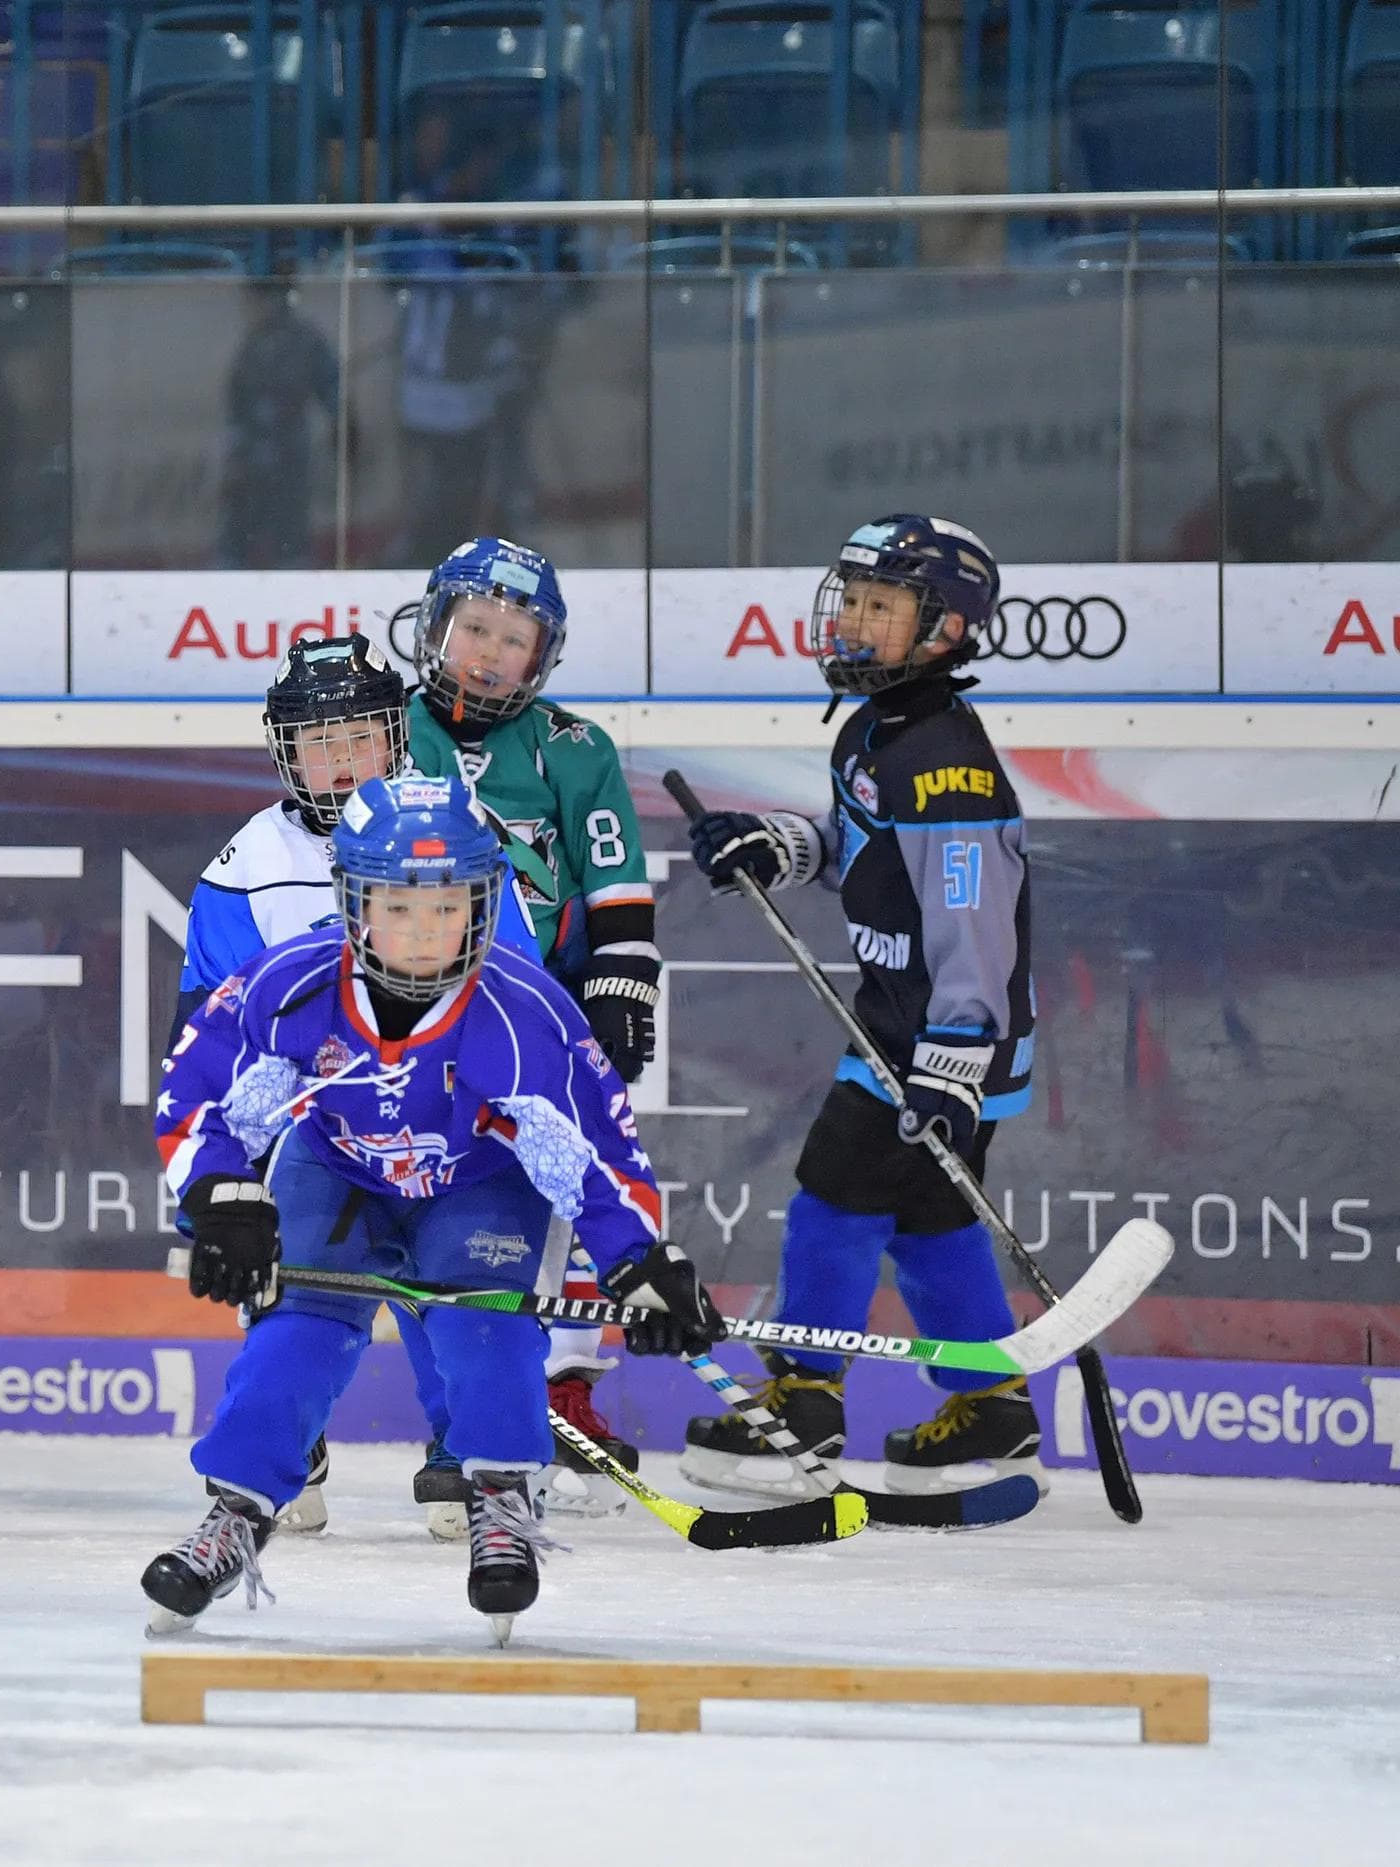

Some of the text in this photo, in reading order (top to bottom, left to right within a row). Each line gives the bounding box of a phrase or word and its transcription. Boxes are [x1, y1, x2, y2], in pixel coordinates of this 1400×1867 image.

[726, 604, 836, 659] Au
[913, 766, 995, 813] JUKE!
[400, 857, 457, 868] BAUER
[586, 808, 627, 868] 8
[942, 840, 982, 910] 51
[536, 1296, 650, 1325] PROJECT
